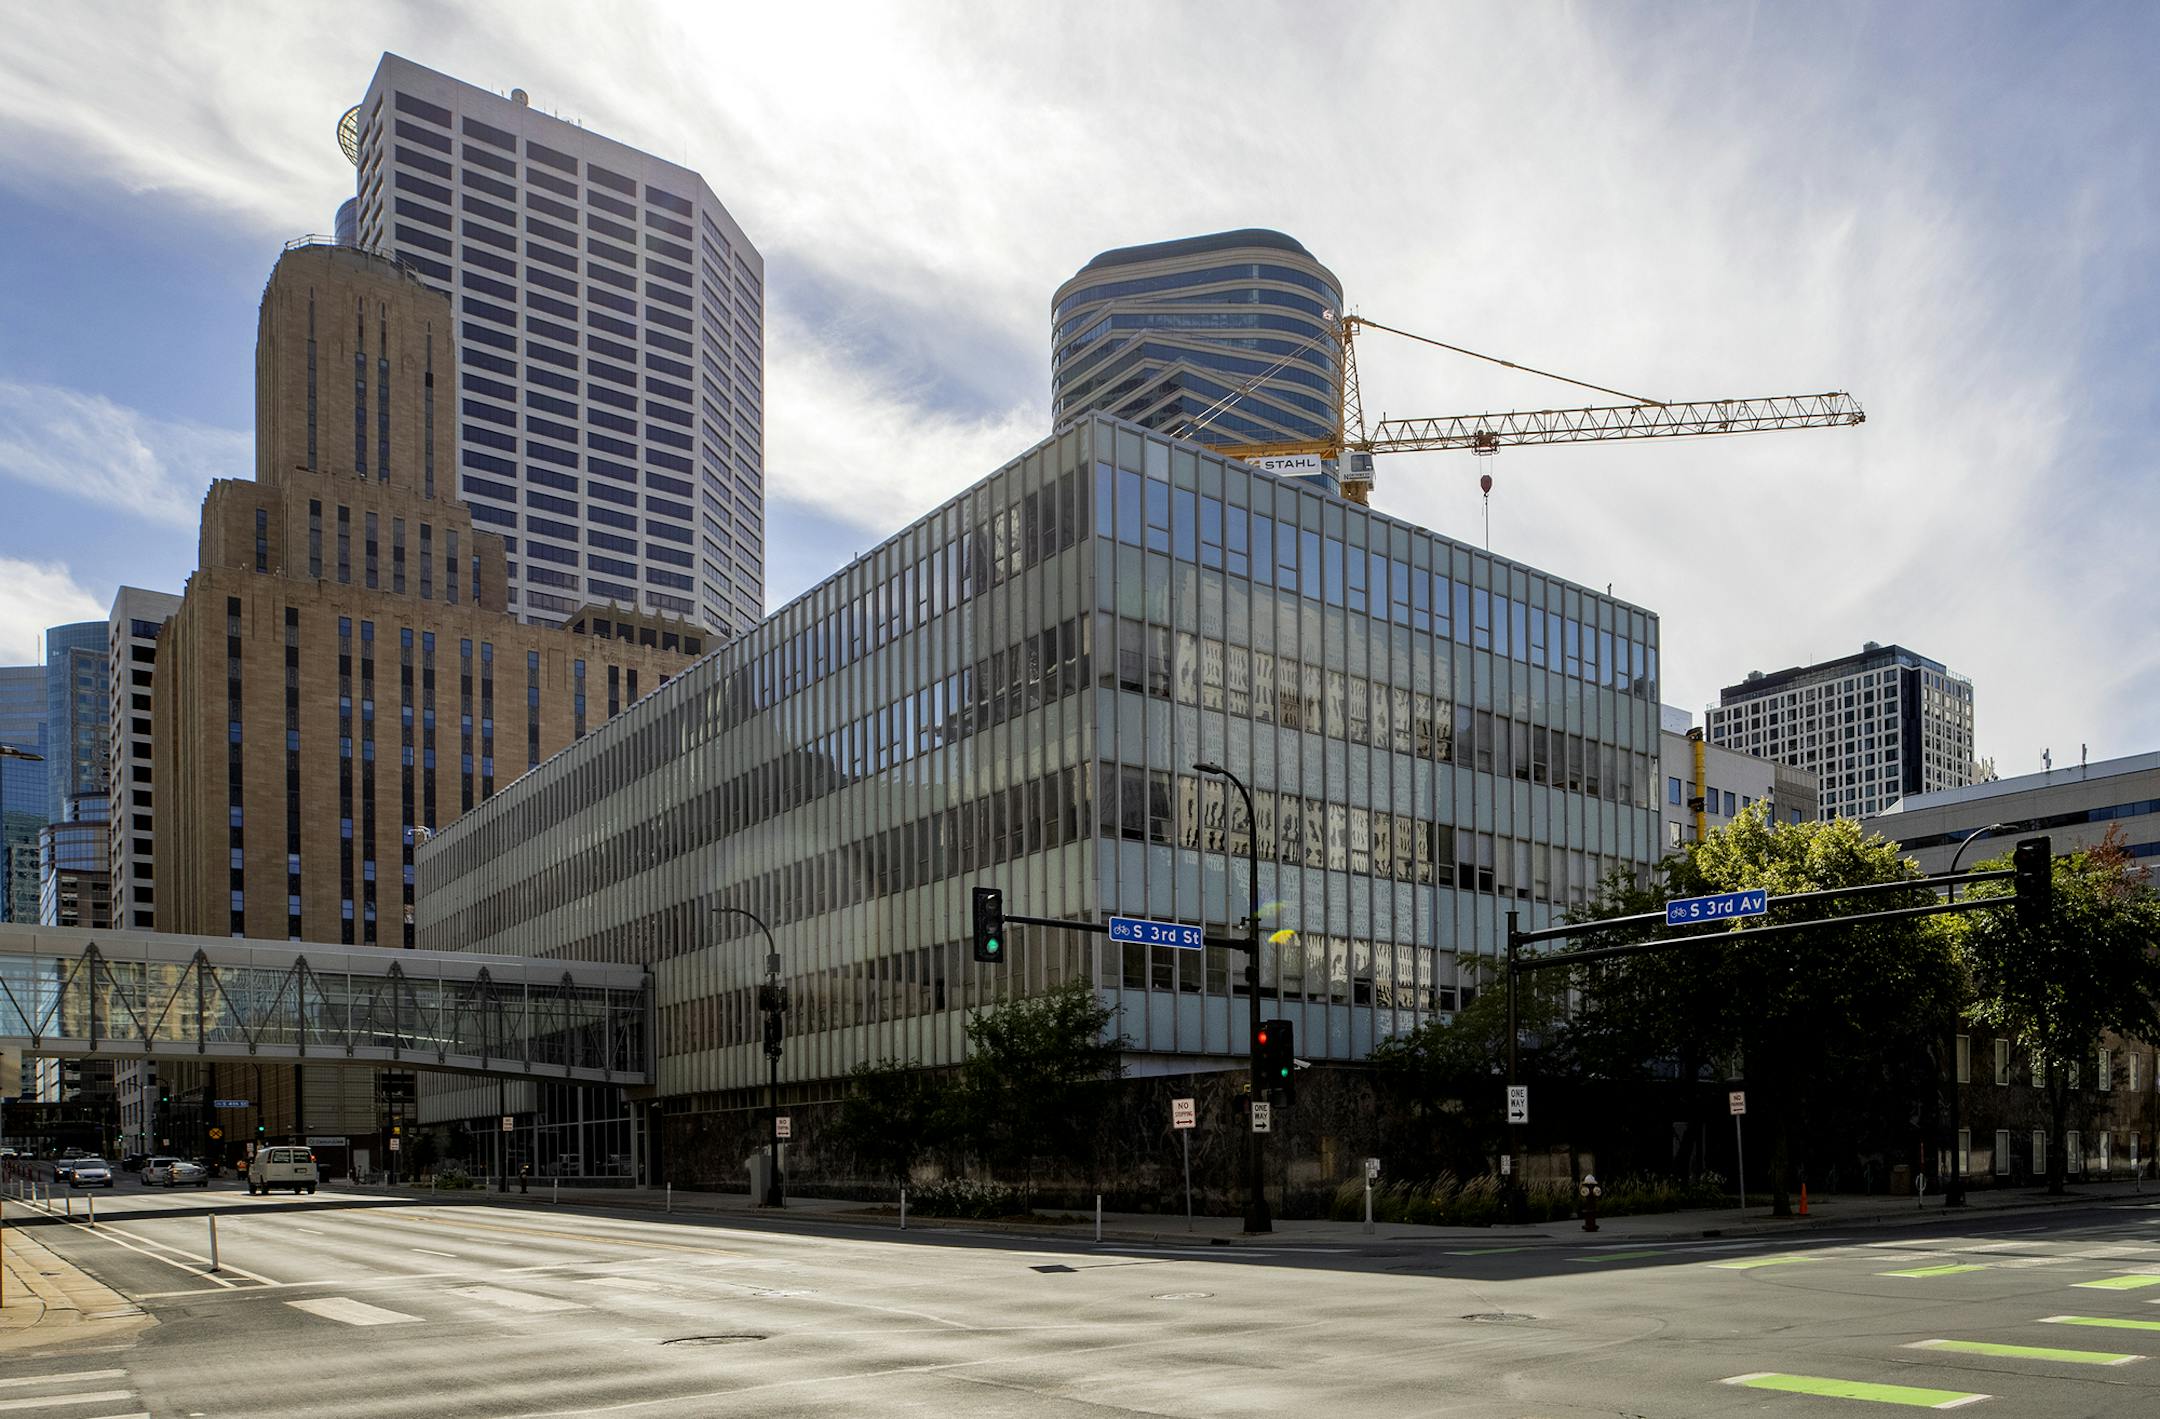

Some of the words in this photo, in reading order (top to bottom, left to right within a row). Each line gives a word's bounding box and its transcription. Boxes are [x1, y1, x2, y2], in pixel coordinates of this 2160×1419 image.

[1265, 459, 1316, 470] STAHL
[1690, 903, 1700, 917] S
[1706, 899, 1733, 916] 3rd
[1740, 896, 1762, 911] Av
[1133, 924, 1143, 938] S
[1150, 926, 1176, 942] 3rd
[1183, 930, 1199, 945] St
[1511, 1089, 1525, 1098] ONE
[1178, 1102, 1189, 1110] NO
[1511, 1099, 1525, 1107] WAY
